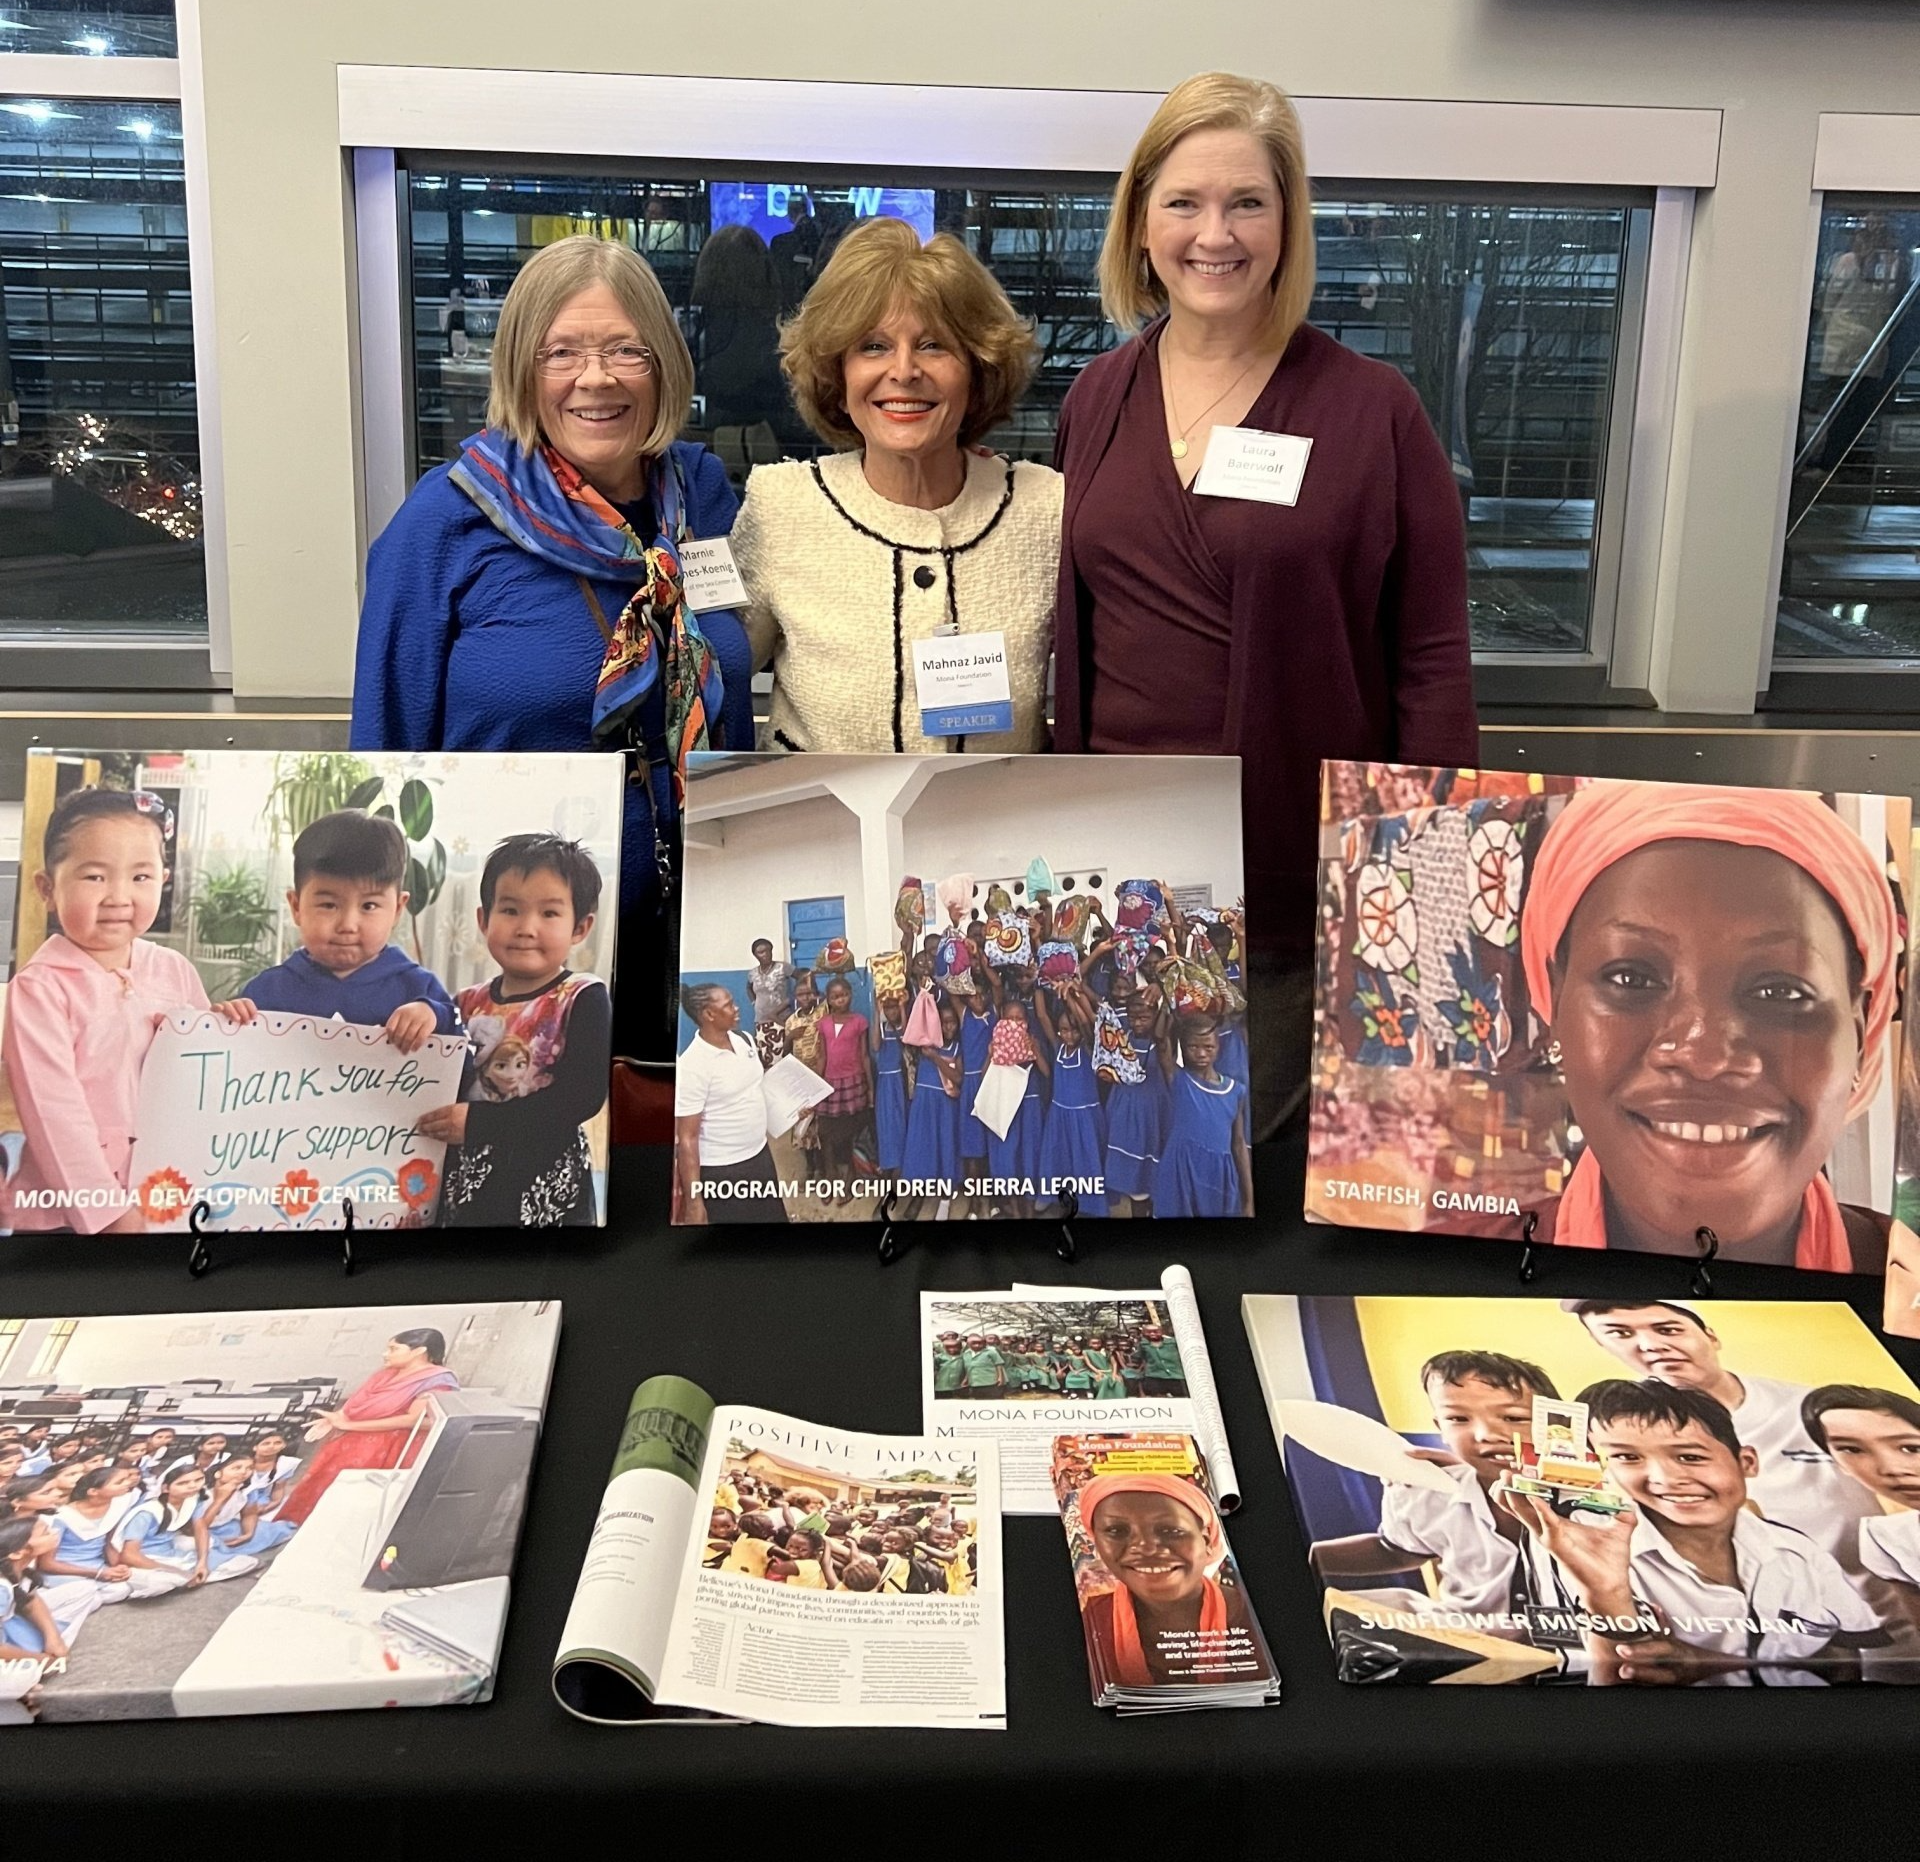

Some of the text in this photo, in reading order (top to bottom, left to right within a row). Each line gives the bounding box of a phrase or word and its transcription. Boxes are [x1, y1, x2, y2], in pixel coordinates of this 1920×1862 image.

[1242, 444, 1276, 457] Laura
[1228, 458, 1284, 474] Baerwolf
[680, 548, 715, 561] Marnie
[922, 652, 1003, 671] Mahnaz Javid
[939, 714, 997, 728] SPEAKER
[181, 1050, 440, 1113] Thank you for
[204, 1123, 422, 1176] your support
[15, 1184, 400, 1209] MONGOLIA DEVELOPMENT CENTRE
[690, 1179, 798, 1199] PROGRAM
[804, 1178, 845, 1198] FOR
[963, 1177, 1035, 1198] SIERRA
[1040, 1175, 1105, 1196] LEONE
[1324, 1179, 1521, 1216] STARFISH, GAMBIA
[959, 1406, 1173, 1421] MONA FOUNDATION
[729, 1419, 977, 1463] POSITIVE IMPACT
[1078, 1440, 1182, 1450] Mona Foundation
[726, 1589, 753, 1600] strives
[755, 1593, 764, 1602] to
[766, 1597, 801, 1610] improve
[887, 1608, 905, 1616] and
[906, 1608, 948, 1617] countries
[949, 1609, 961, 1619] by
[744, 1582, 770, 1595] Mona
[825, 1596, 860, 1607] through
[870, 1599, 924, 1608] decolonized
[926, 1600, 968, 1610] approach
[970, 1601, 981, 1609] to
[695, 1594, 728, 1608] porting
[729, 1600, 757, 1612] global
[758, 1606, 796, 1619] partners
[797, 1611, 832, 1622] focused
[848, 1616, 893, 1625] education
[906, 1618, 948, 1627] especially
[951, 1618, 962, 1626] of
[744, 1622, 774, 1635] Actor
[1221, 1629, 1230, 1637] is
[1230, 1627, 1249, 1635] life-
[1358, 1610, 1808, 1636] SUNFLOWER MISSION, VIETNAM
[1157, 1638, 1253, 1649] saving, life-changing,
[1165, 1651, 1182, 1659] and
